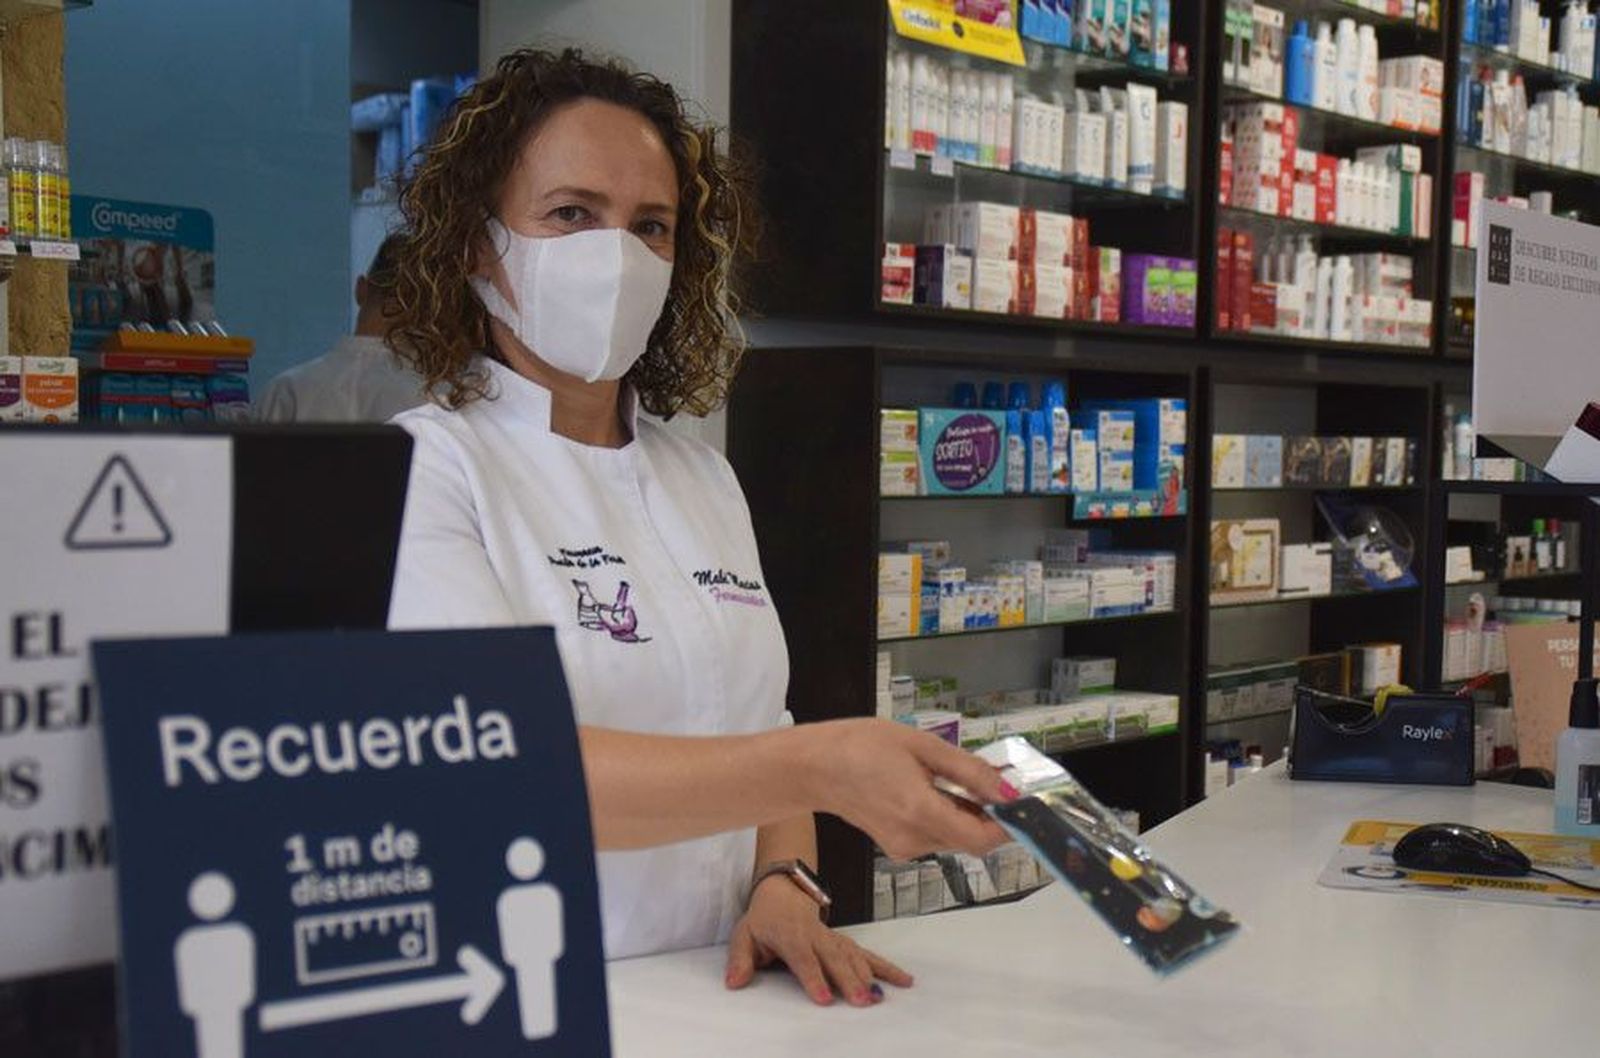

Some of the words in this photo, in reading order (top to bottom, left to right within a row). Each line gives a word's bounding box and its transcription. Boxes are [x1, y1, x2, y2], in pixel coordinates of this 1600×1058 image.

[91, 201, 178, 233] Compeed
[11, 611, 78, 661] EL
[158, 694, 519, 788] Recuerda
[285, 833, 314, 874] 1
[323, 836, 362, 870] m
[370, 822, 421, 864] de
[290, 862, 433, 908] distancia
